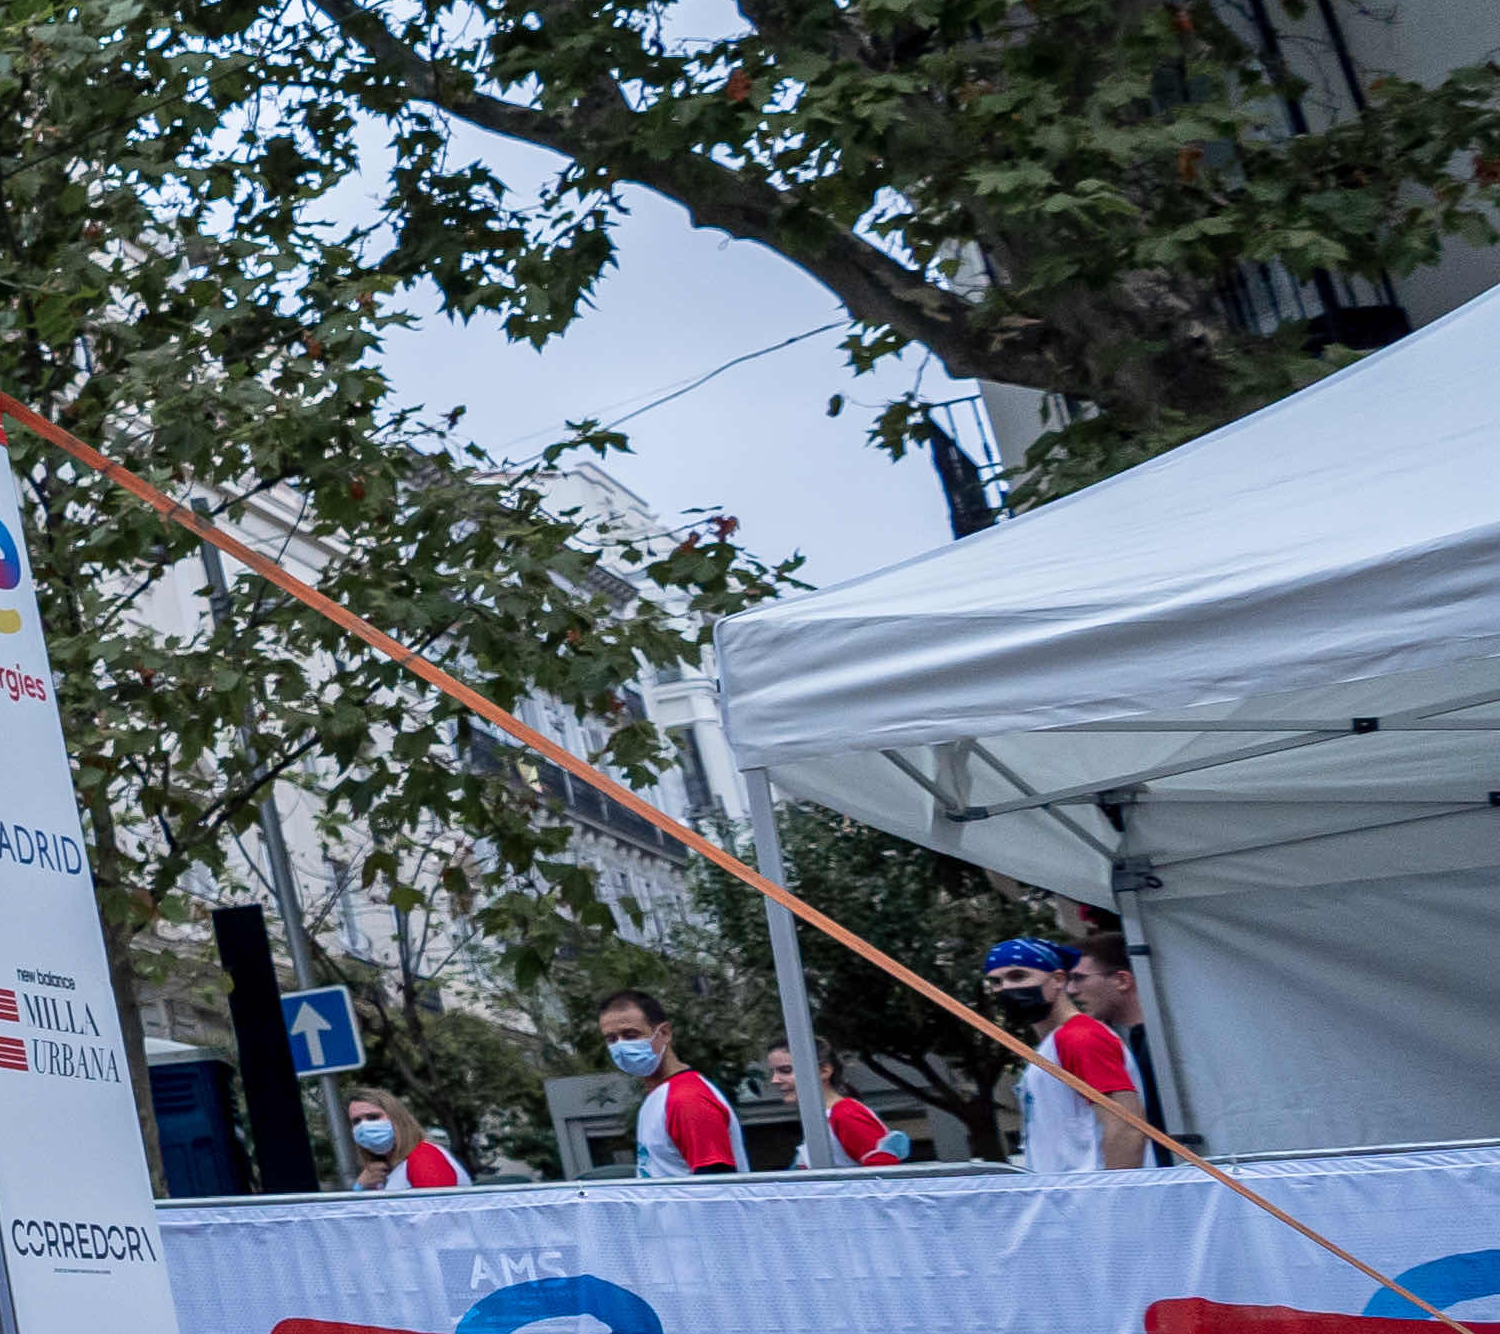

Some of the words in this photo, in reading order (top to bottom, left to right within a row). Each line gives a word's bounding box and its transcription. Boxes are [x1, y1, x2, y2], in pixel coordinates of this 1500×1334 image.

[16, 967, 36, 984] new
[36, 969, 76, 991] balance
[23, 992, 101, 1038] MILLA
[32, 1039, 122, 1084] URBANA
[469, 1251, 565, 1290] AMS
